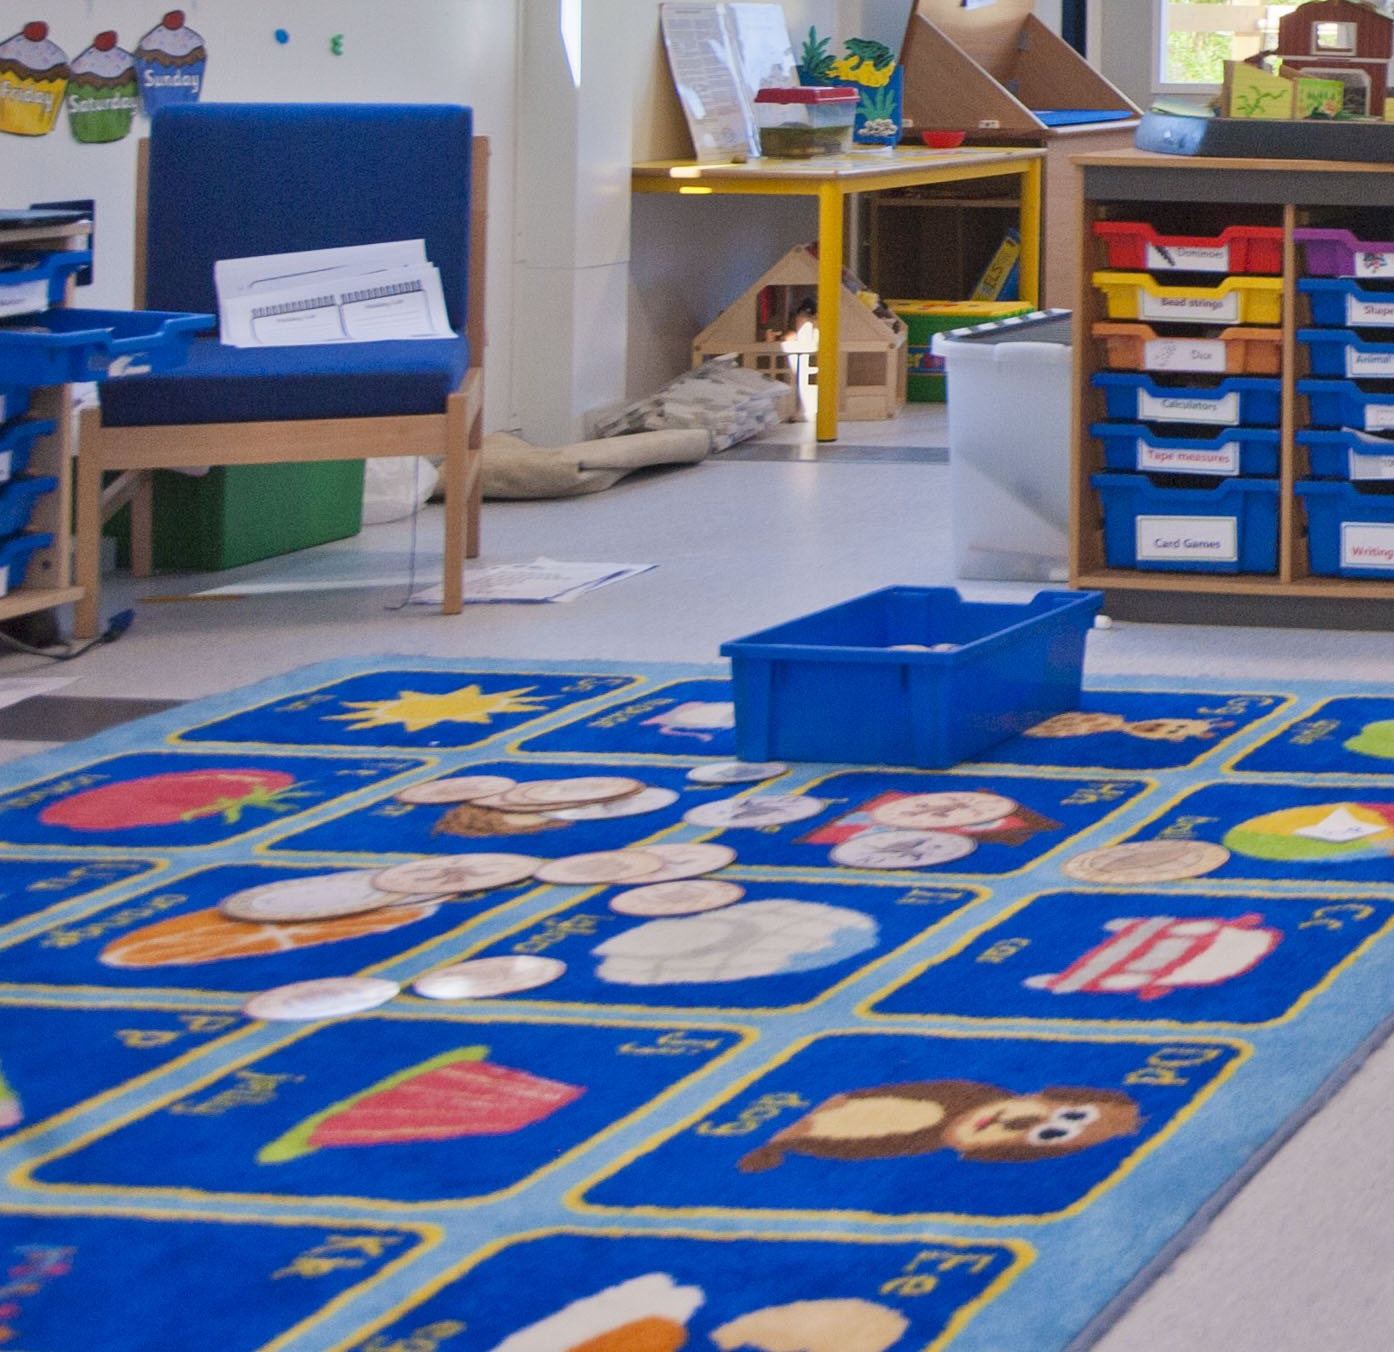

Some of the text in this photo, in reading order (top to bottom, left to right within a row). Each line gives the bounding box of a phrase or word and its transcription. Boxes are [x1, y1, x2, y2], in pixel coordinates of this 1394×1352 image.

[143, 69, 200, 93] Sunday
[1177, 247, 1224, 259] Dominoes
[1161, 298, 1224, 312] Bead strings
[1191, 349, 1214, 361] Dice
[1356, 355, 1392, 365] Animal
[1162, 399, 1217, 412] Calculators
[1148, 450, 1231, 464] Tape measures
[1154, 538, 1221, 550] Card Games
[1351, 546, 1394, 560] Writing
[1198, 696, 1274, 716] Gg
[1291, 719, 1341, 744] apple
[1060, 783, 1125, 806] Hh
[41, 894, 188, 948] orange
[1299, 903, 1375, 930] Cc
[513, 914, 615, 953] igloo
[975, 938, 1031, 963] car
[115, 1014, 237, 1048] Pp
[616, 1032, 724, 1056] Jj
[1123, 1048, 1221, 1085] Dd
[170, 1070, 306, 1115] jelly
[697, 1092, 811, 1135] dog
[270, 1235, 402, 1279] Kk
[881, 1251, 993, 1295] Ee
